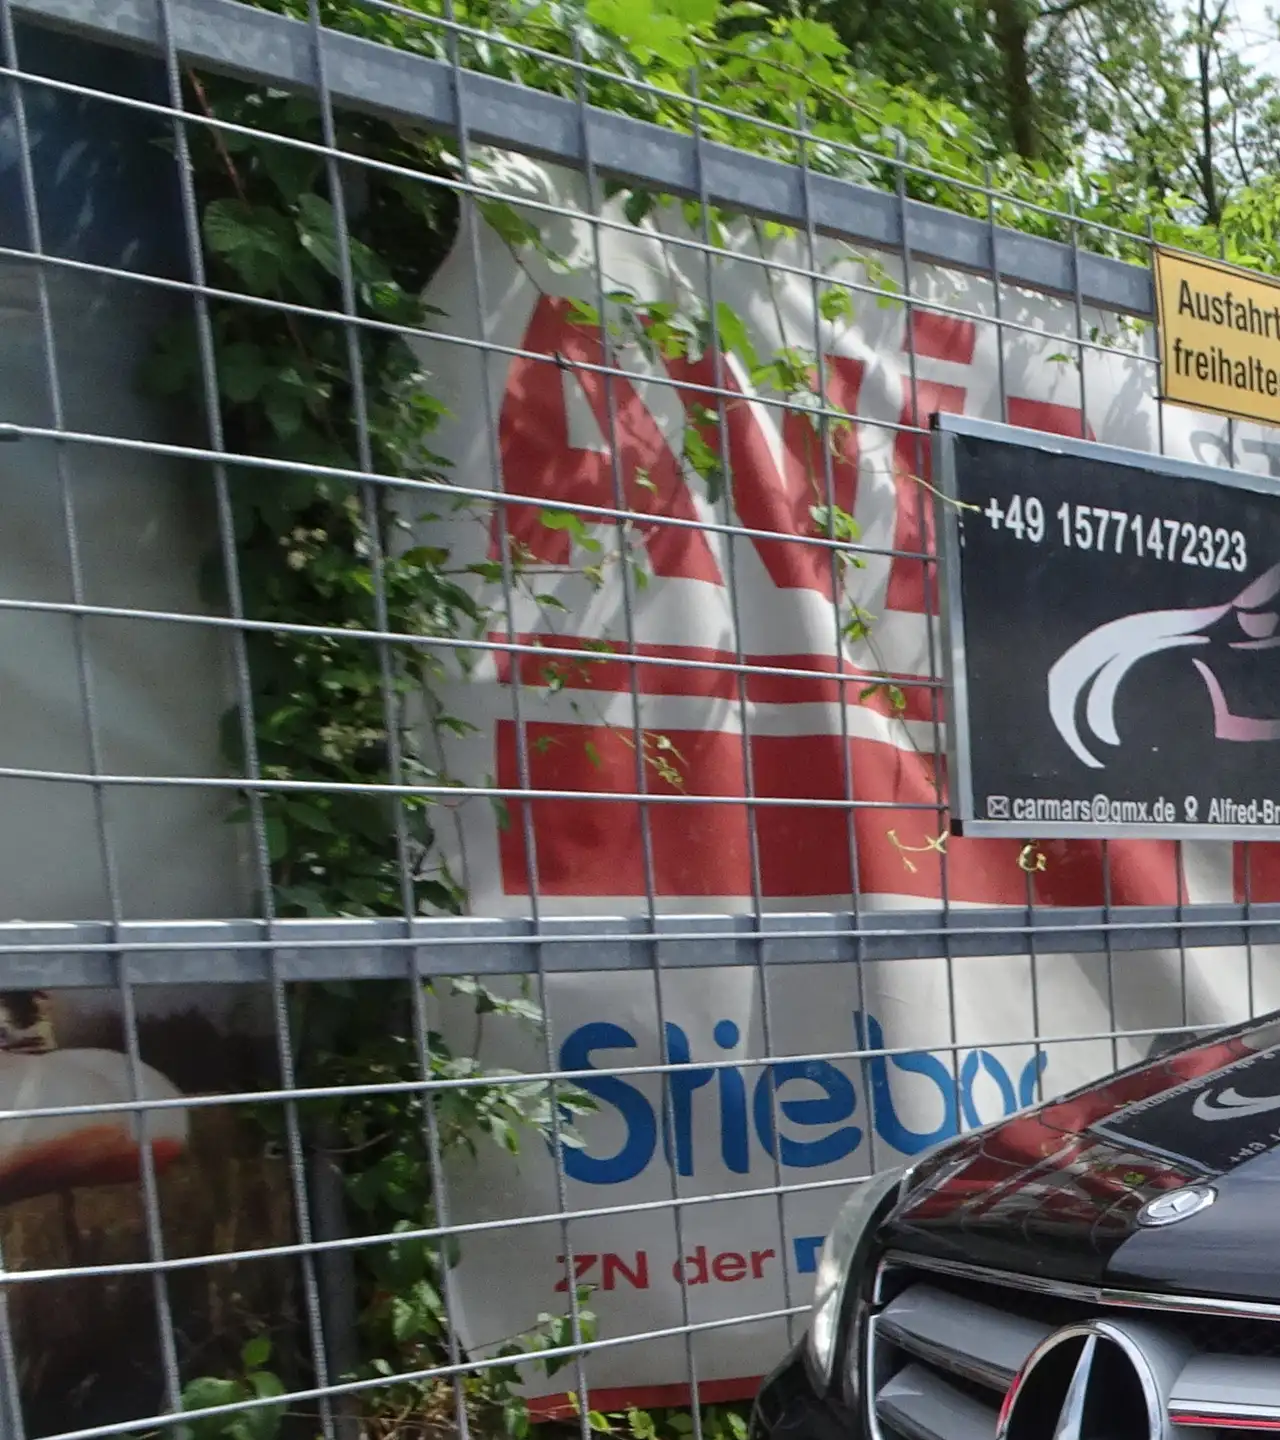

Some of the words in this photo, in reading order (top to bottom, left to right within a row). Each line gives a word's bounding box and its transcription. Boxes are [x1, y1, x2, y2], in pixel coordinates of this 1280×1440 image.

[488, 295, 1096, 618] AVI
[984, 494, 1045, 544] +49
[1057, 502, 1247, 573] 15771472323
[1013, 794, 1176, 823] carmars@gmx.de
[554, 1250, 649, 1293] ZN
[672, 1245, 775, 1287] der
